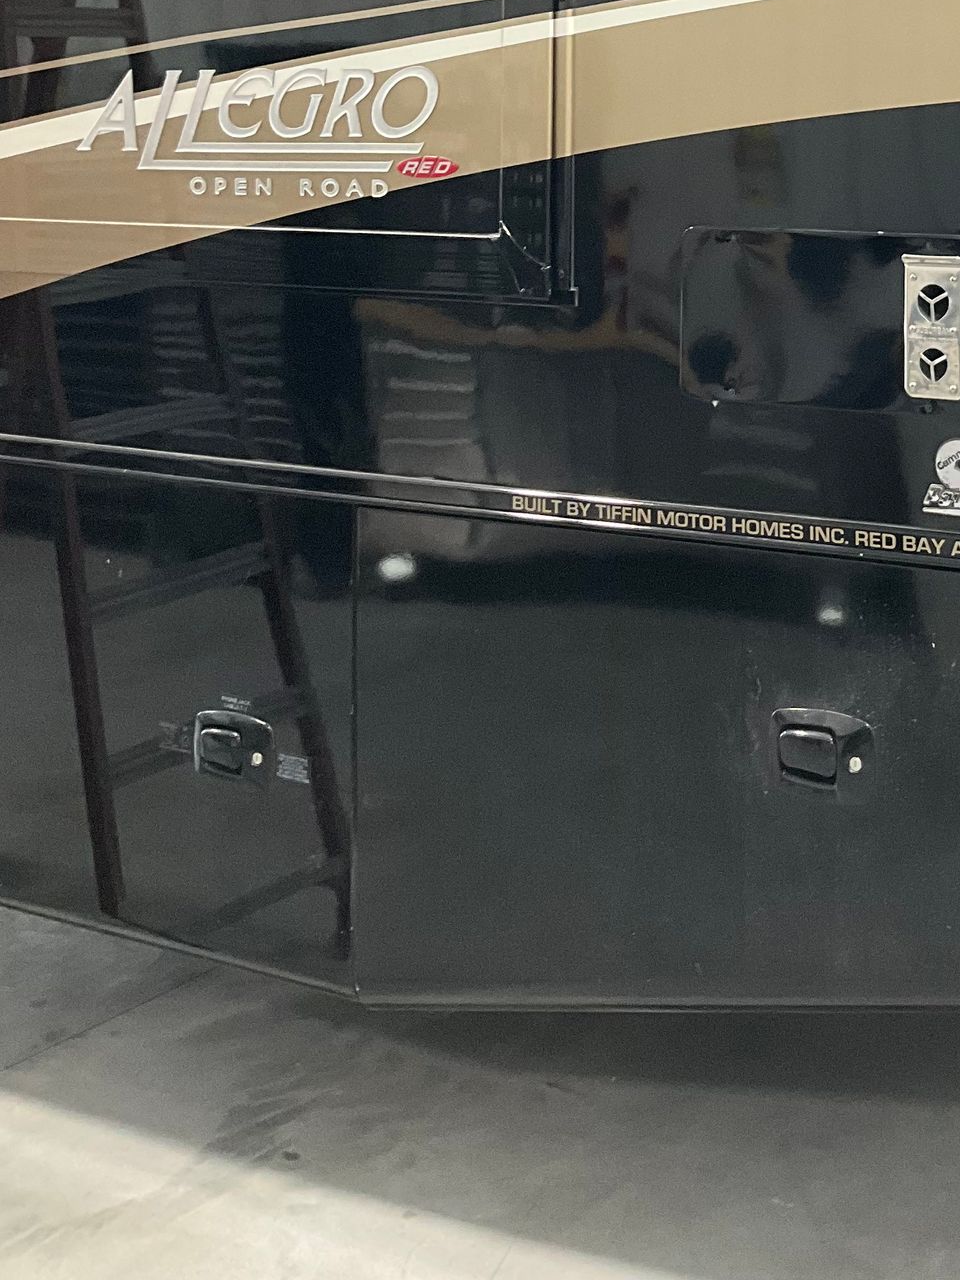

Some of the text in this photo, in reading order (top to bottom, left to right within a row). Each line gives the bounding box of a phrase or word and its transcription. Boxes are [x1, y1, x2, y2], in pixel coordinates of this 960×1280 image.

[76, 65, 438, 170] ALLEGRO
[189, 175, 389, 198] OPEN ROAD
[402, 159, 452, 174] RED
[512, 495, 562, 514] BUILT
[566, 502, 591, 517] BY
[595, 503, 652, 524] TIFFIN
[657, 510, 726, 532] MOTOR
[732, 518, 804, 539] HOMES
[809, 525, 849, 545] INC.
[855, 530, 896, 550] RED
[902, 536, 944, 555] BAY
